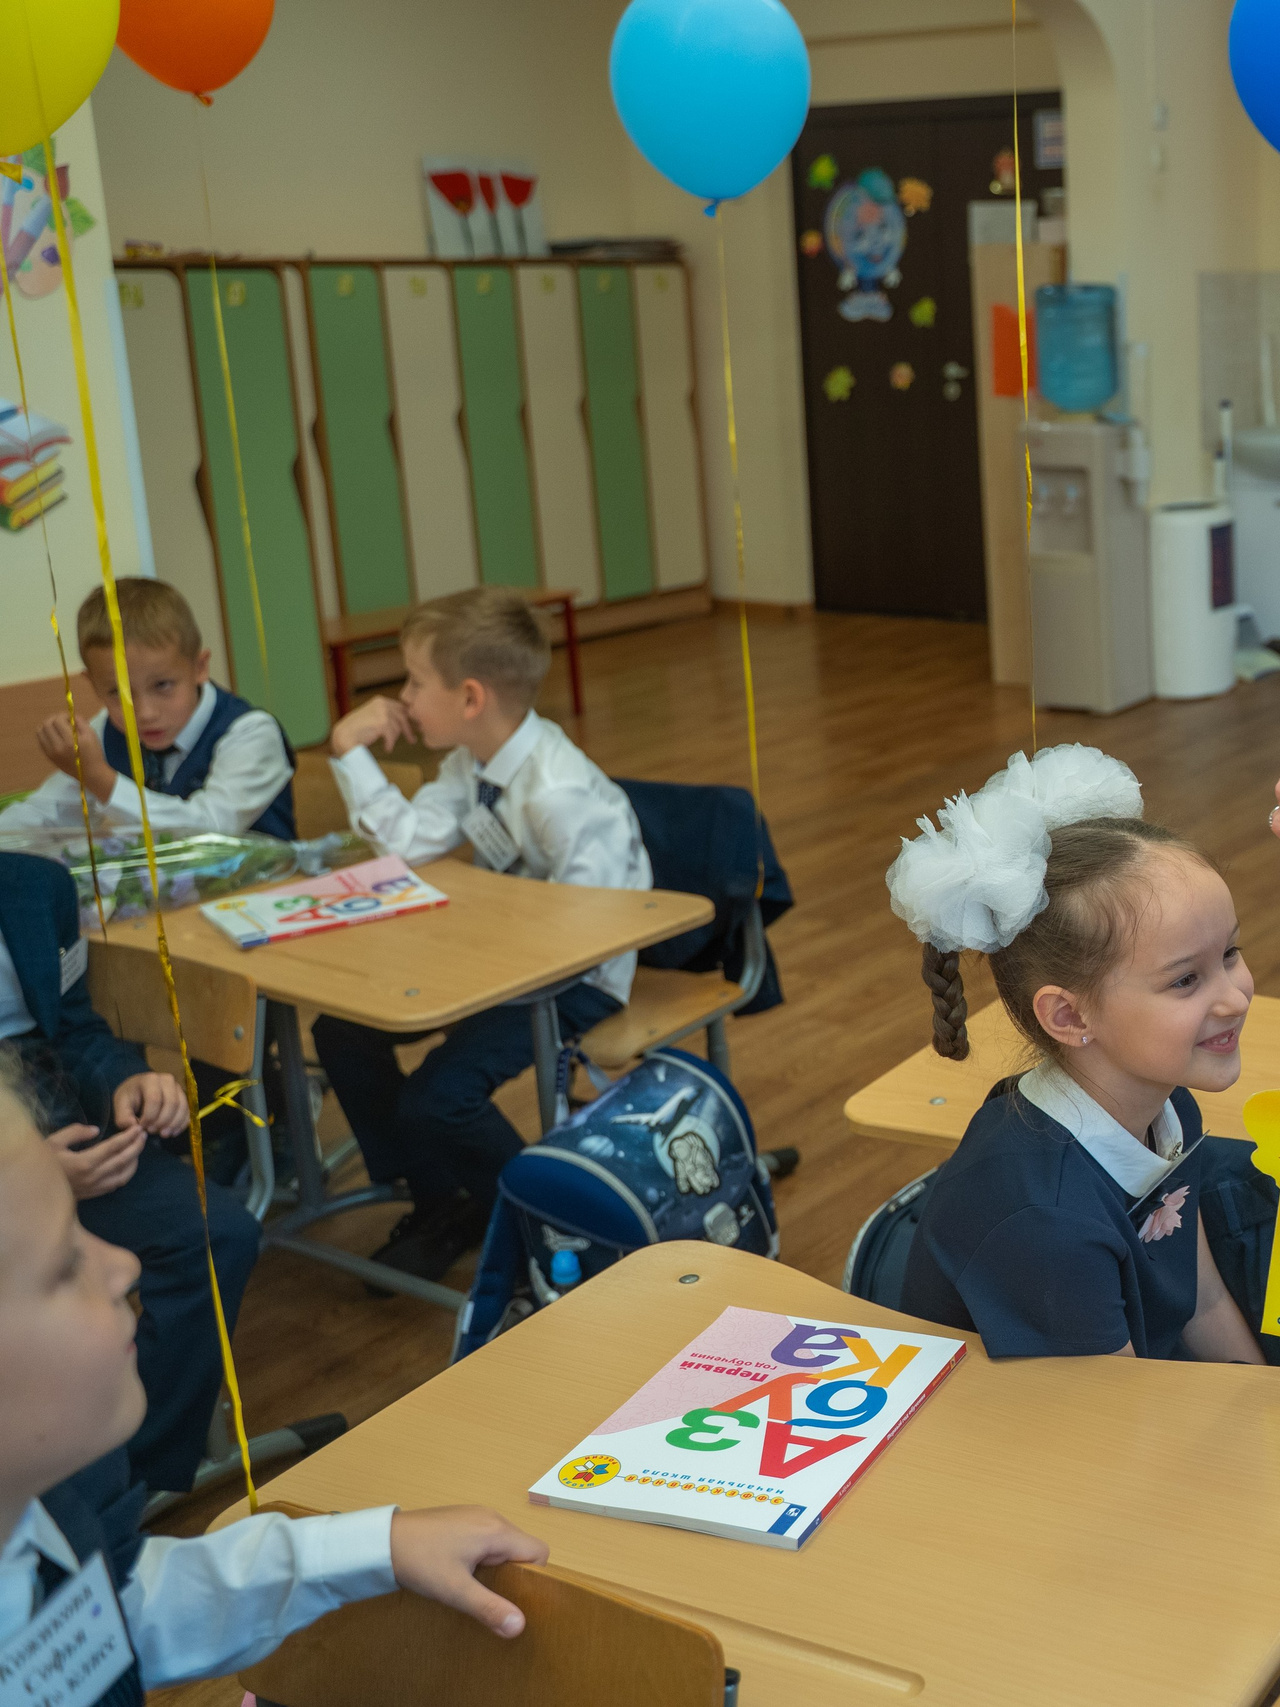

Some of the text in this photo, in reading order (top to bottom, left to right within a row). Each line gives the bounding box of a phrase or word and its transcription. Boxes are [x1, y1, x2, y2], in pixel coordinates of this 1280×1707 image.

[680, 1360, 769, 1383] Первый
[690, 1352, 778, 1371] год обучения
[625, 1475, 783, 1504] ЭФФЕКТИВНАЯ
[642, 1469, 784, 1494] начальная школа
